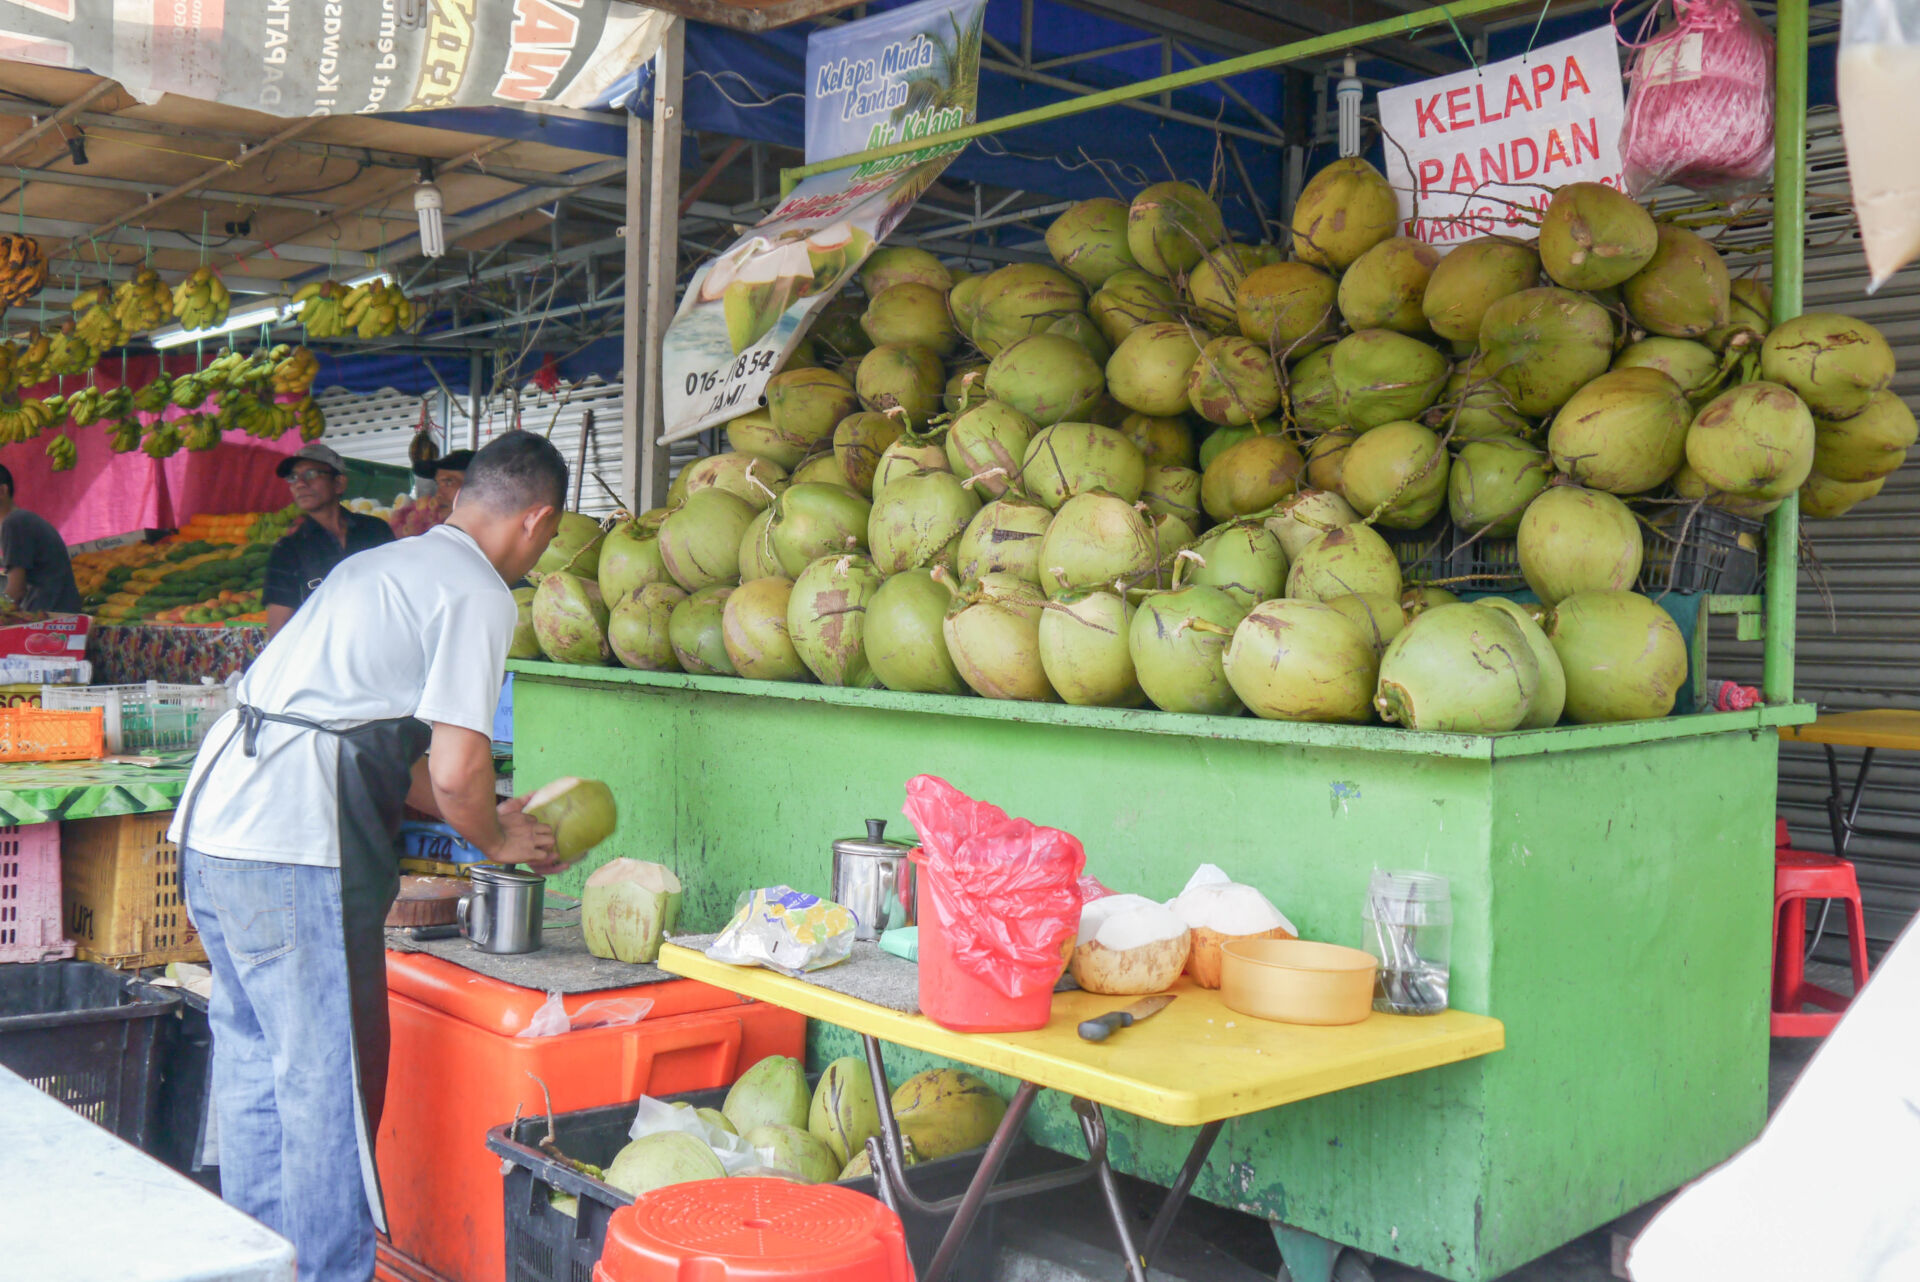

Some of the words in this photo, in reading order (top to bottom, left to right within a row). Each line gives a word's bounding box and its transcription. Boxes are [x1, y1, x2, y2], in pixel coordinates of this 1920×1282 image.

[816, 57, 874, 98] Kelapa
[880, 34, 933, 78] Muda
[1415, 55, 1590, 138] KELAPA
[842, 78, 908, 122] Pandan
[865, 121, 897, 150] Air
[1418, 117, 1599, 200] PANDAN
